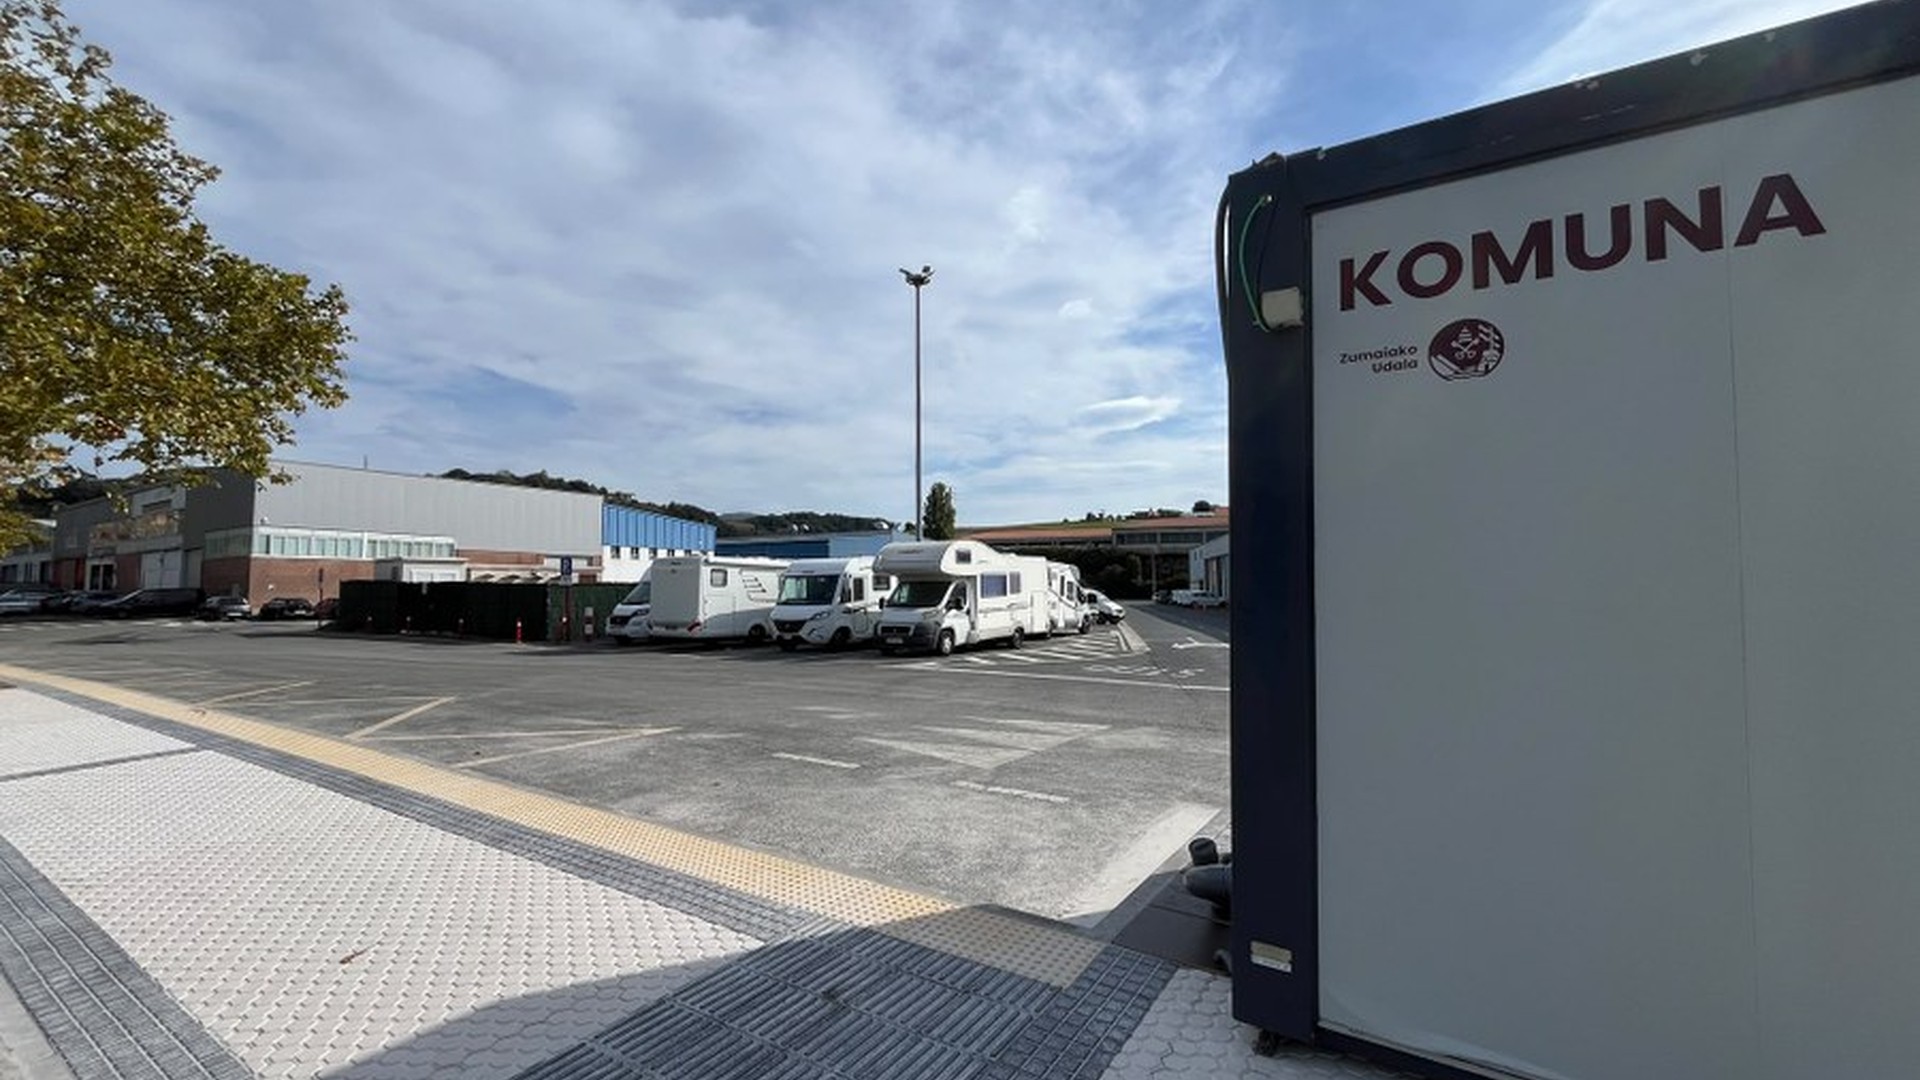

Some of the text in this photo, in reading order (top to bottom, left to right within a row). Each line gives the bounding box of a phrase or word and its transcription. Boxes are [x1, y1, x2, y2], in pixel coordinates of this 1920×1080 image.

[1339, 173, 1826, 311] KOMUNA
[1339, 345, 1418, 364] Zumaiako
[1372, 359, 1418, 373] Udala
